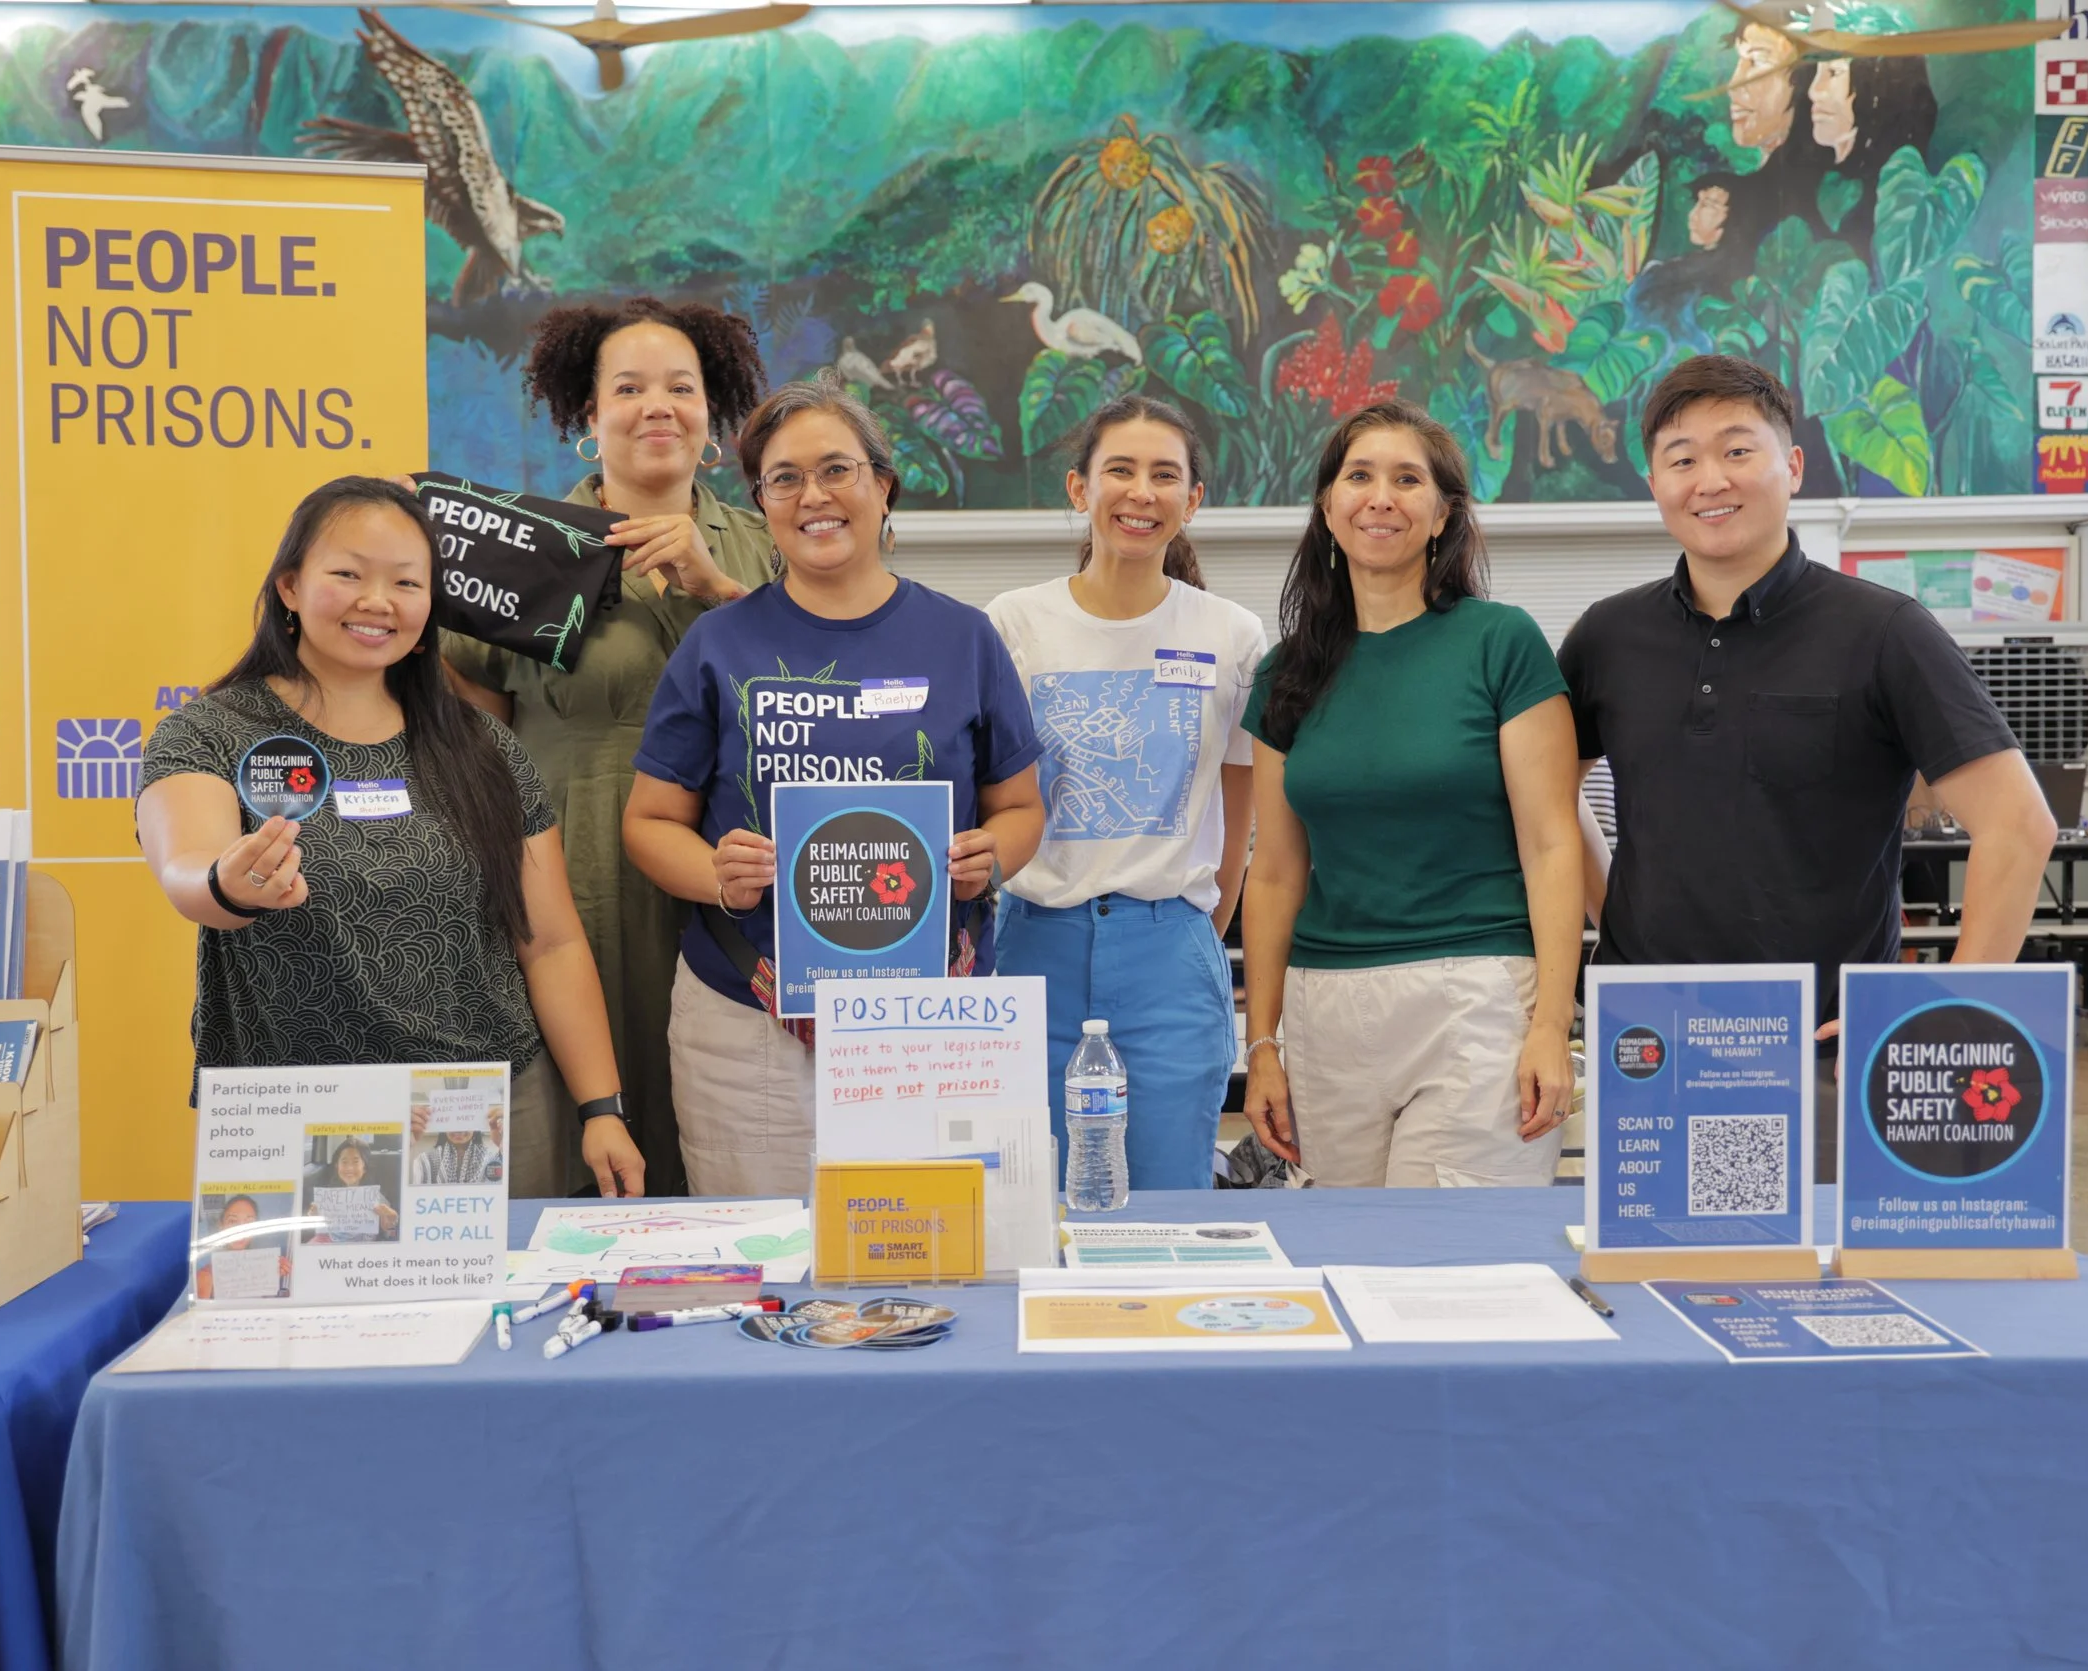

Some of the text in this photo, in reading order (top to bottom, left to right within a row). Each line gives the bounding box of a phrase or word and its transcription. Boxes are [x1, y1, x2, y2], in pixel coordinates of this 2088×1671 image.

[44, 226, 337, 298] PEOPLE.
[46, 305, 194, 370] NOT
[49, 382, 372, 449] PRISONS.
[2045, 406, 2088, 418] ELEVEN
[428, 496, 536, 553] PEOPLE.
[436, 533, 475, 562] OT
[1176, 651, 1195, 659] Hello
[1160, 660, 1207, 685] Emily
[883, 679, 904, 687] Hello
[756, 720, 816, 747] NOT
[250, 755, 313, 767] REIMAGINING
[756, 753, 891, 782] PRISONS.
[251, 768, 284, 780] PUBLIC
[251, 781, 285, 793] SAFETY
[279, 794, 314, 803] COALITION
[343, 793, 400, 804] Kristen
[809, 842, 910, 861] REIMAGINING
[810, 864, 863, 883] PUBLIC
[810, 886, 865, 905] SAFETY
[856, 906, 911, 921] COALITION
[806, 966, 921, 979] Follow us on Instagram:
[833, 995, 1018, 1025] POSTCARDS
[1688, 1017, 1789, 1034] REIMAGINING
[1618, 1037, 1658, 1046] REIMAGINING
[1687, 1035, 1788, 1046] PUBLIC SAFETY
[829, 1040, 1021, 1057] Write to your legislators
[1618, 1046, 1640, 1054] PUBLIC
[1711, 1047, 1722, 1058] IN
[1887, 1043, 2015, 1066] REIMAGINING
[1618, 1055, 1641, 1063] SAFETY
[828, 1057, 994, 1079] Tell them to invest in
[1699, 1070, 1721, 1078] Follow
[1742, 1070, 1776, 1079] Instagram:
[212, 1082, 340, 1097] Participate in our
[833, 1078, 1006, 1101] people not prisons.
[1887, 1070, 1954, 1094] PUBLIC
[211, 1102, 302, 1116] social media
[1886, 1098, 1956, 1121] SAFETY
[1617, 1116, 1674, 1131] SCAN TO
[210, 1124, 254, 1140] photo
[1944, 1124, 2014, 1141] COALITION
[209, 1145, 285, 1161] campaign!
[1618, 1139, 1660, 1153] LEARN
[1617, 1160, 1661, 1174] ABOUT
[1618, 1182, 1636, 1196] US
[415, 1197, 495, 1215] SAFETY
[704, 1206, 755, 1214] are
[847, 1198, 910, 1212] PEOPLE.
[1618, 1204, 1656, 1218] HERE:
[1878, 1196, 2028, 1214] Follow us on Instagram:
[848, 1218, 949, 1234] NOT PRISONS.
[1850, 1214, 2056, 1233] @reimaginingpublicsafetyhawaii
[414, 1225, 494, 1241] FOR ALL
[599, 1246, 721, 1263] Food
[887, 1242, 924, 1252] SMART
[319, 1255, 494, 1270] What does it mean to you?
[887, 1251, 928, 1260] JUSTICE
[344, 1273, 494, 1288] What does it look like?
